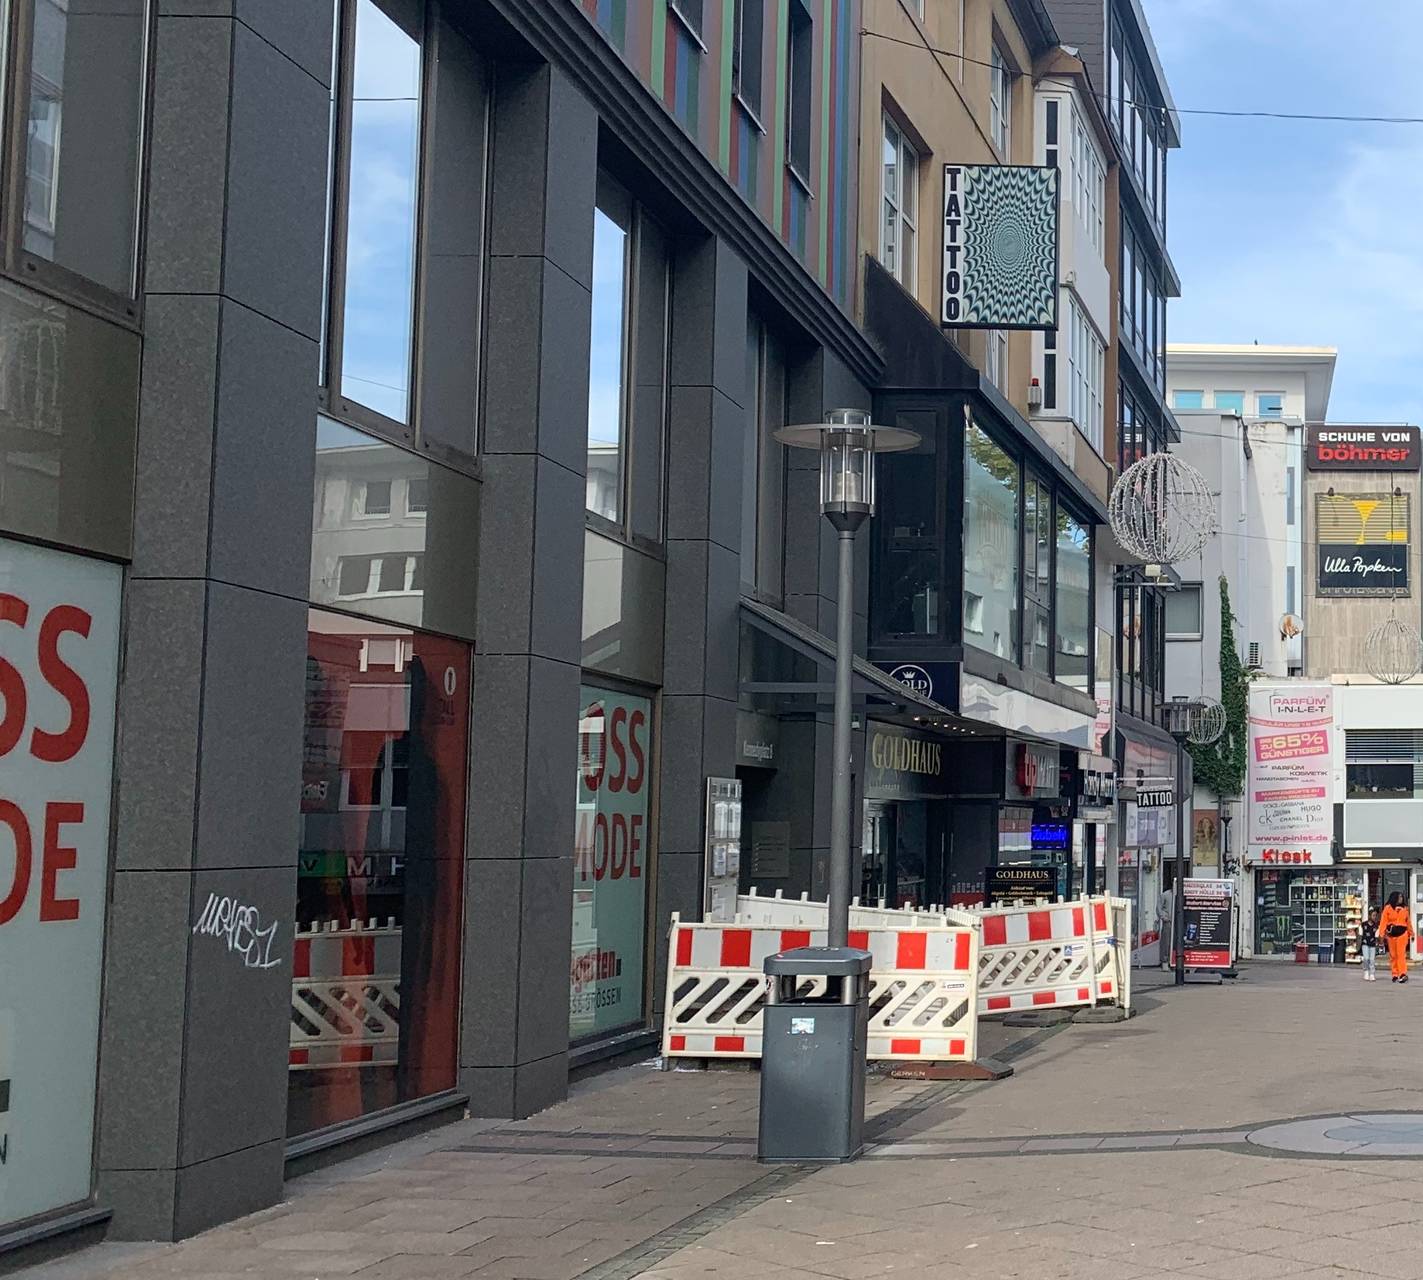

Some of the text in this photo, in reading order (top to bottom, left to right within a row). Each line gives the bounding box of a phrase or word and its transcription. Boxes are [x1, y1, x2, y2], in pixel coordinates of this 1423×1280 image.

[945, 167, 962, 321] TATTOO
[1318, 432, 1411, 442] SCHUHE VON
[1317, 444, 1411, 462] böhmer
[1324, 556, 1351, 573] Ulla
[1273, 695, 1327, 705] PARFÜM
[1273, 732, 1324, 750] 65%
[872, 733, 941, 776] GOLDHAUS
[1260, 747, 1325, 760] GÜNSTIGER
[1137, 792, 1173, 807] TATTOO
[1300, 804, 1322, 813] HUGO
[1262, 848, 1312, 864] Kiosk
[995, 870, 1049, 879] GOLDHAUS
